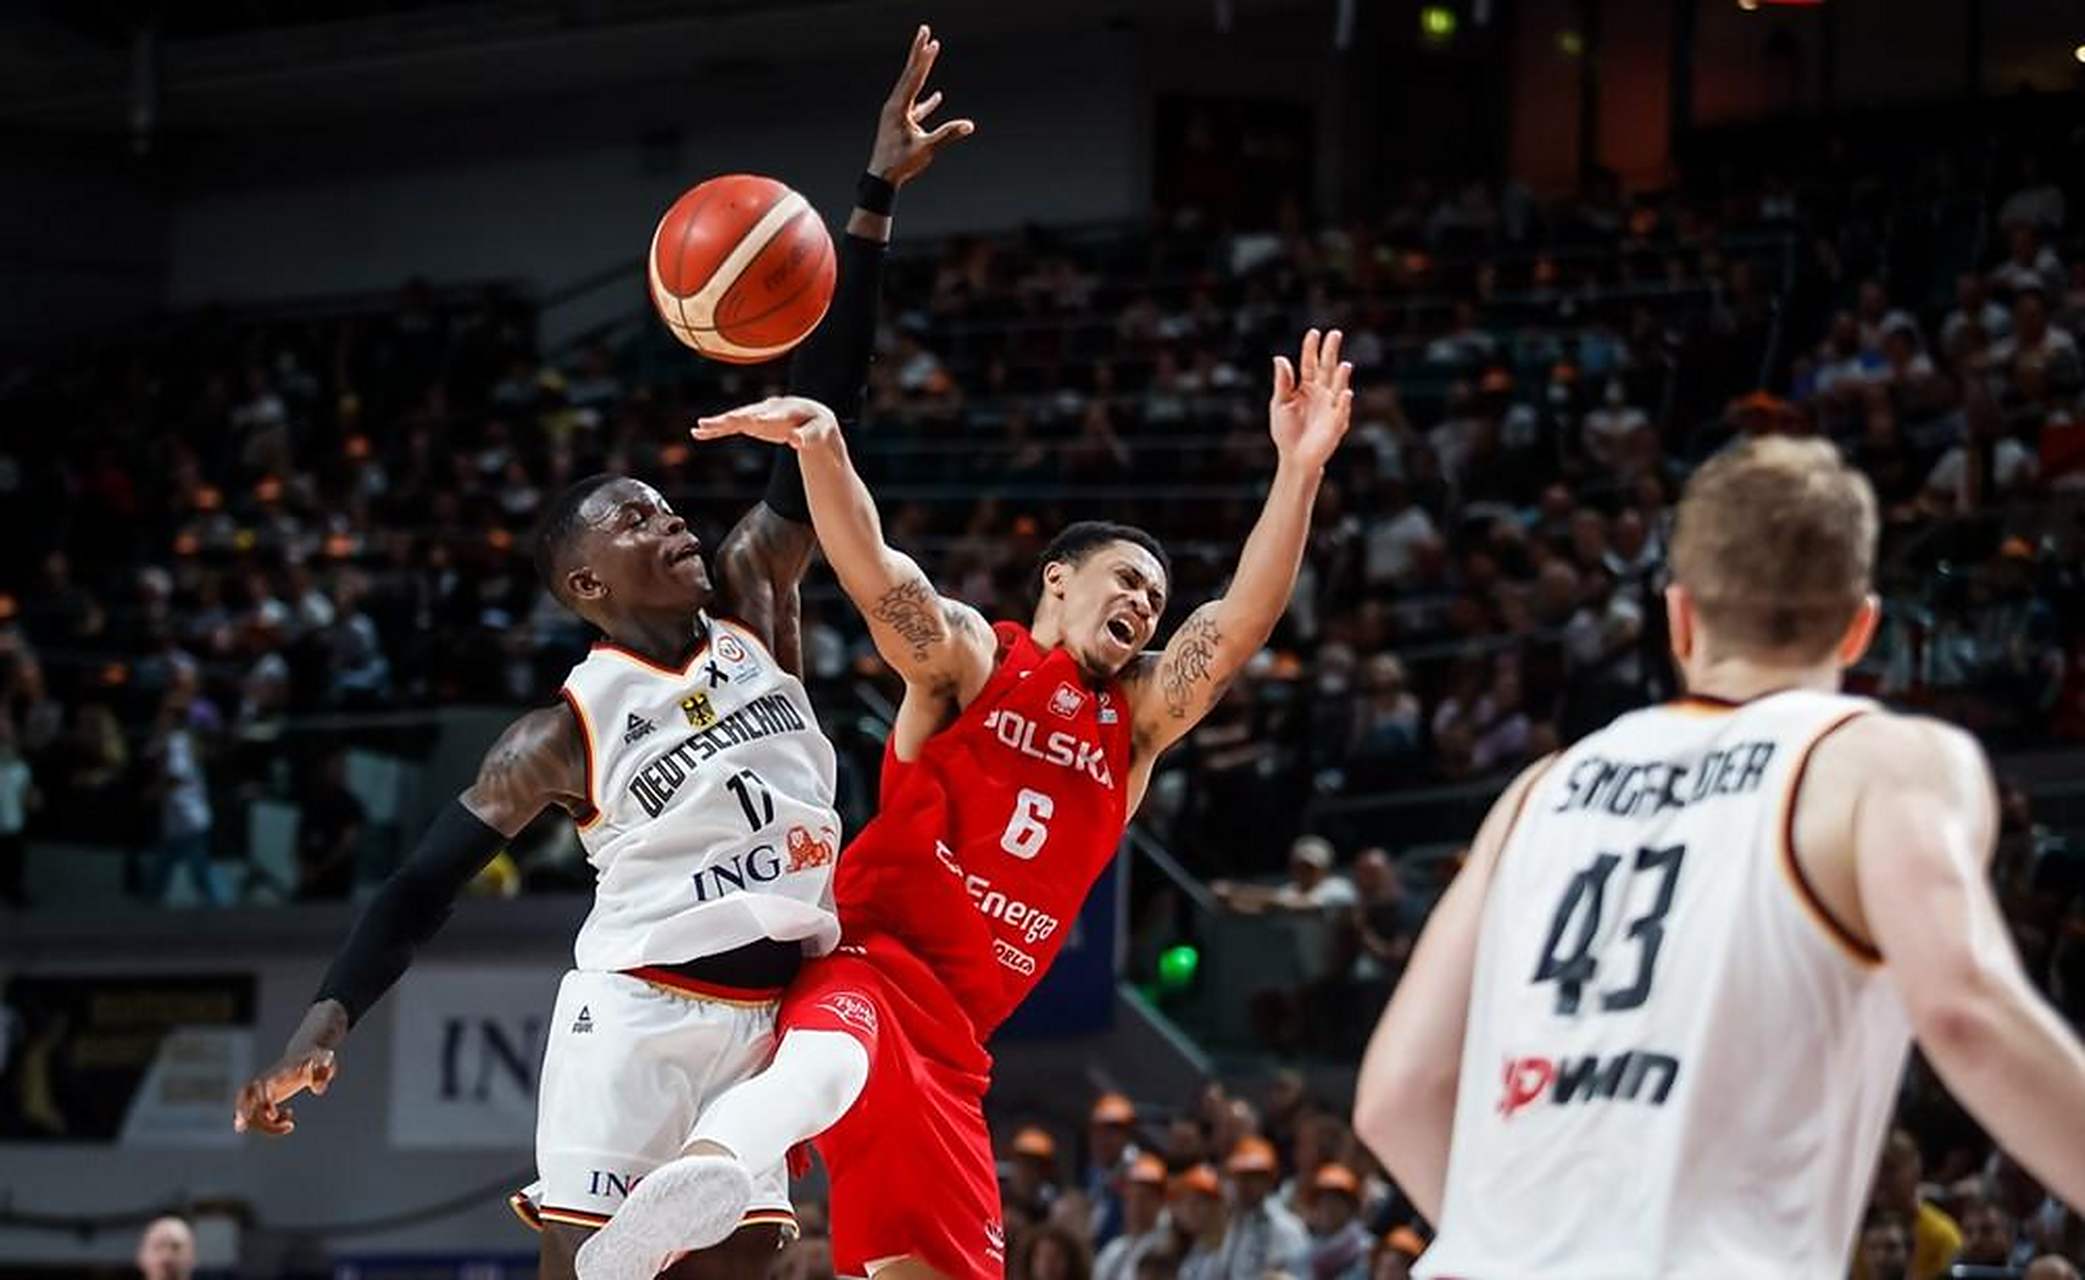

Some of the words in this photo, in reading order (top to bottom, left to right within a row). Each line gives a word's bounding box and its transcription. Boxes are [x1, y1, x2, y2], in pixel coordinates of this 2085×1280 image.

[629, 693, 806, 819] DEUTSCHLAND
[726, 768, 774, 832] 17
[1000, 788, 1054, 860] 6
[693, 844, 780, 901] ING
[1530, 843, 1686, 1015] 43
